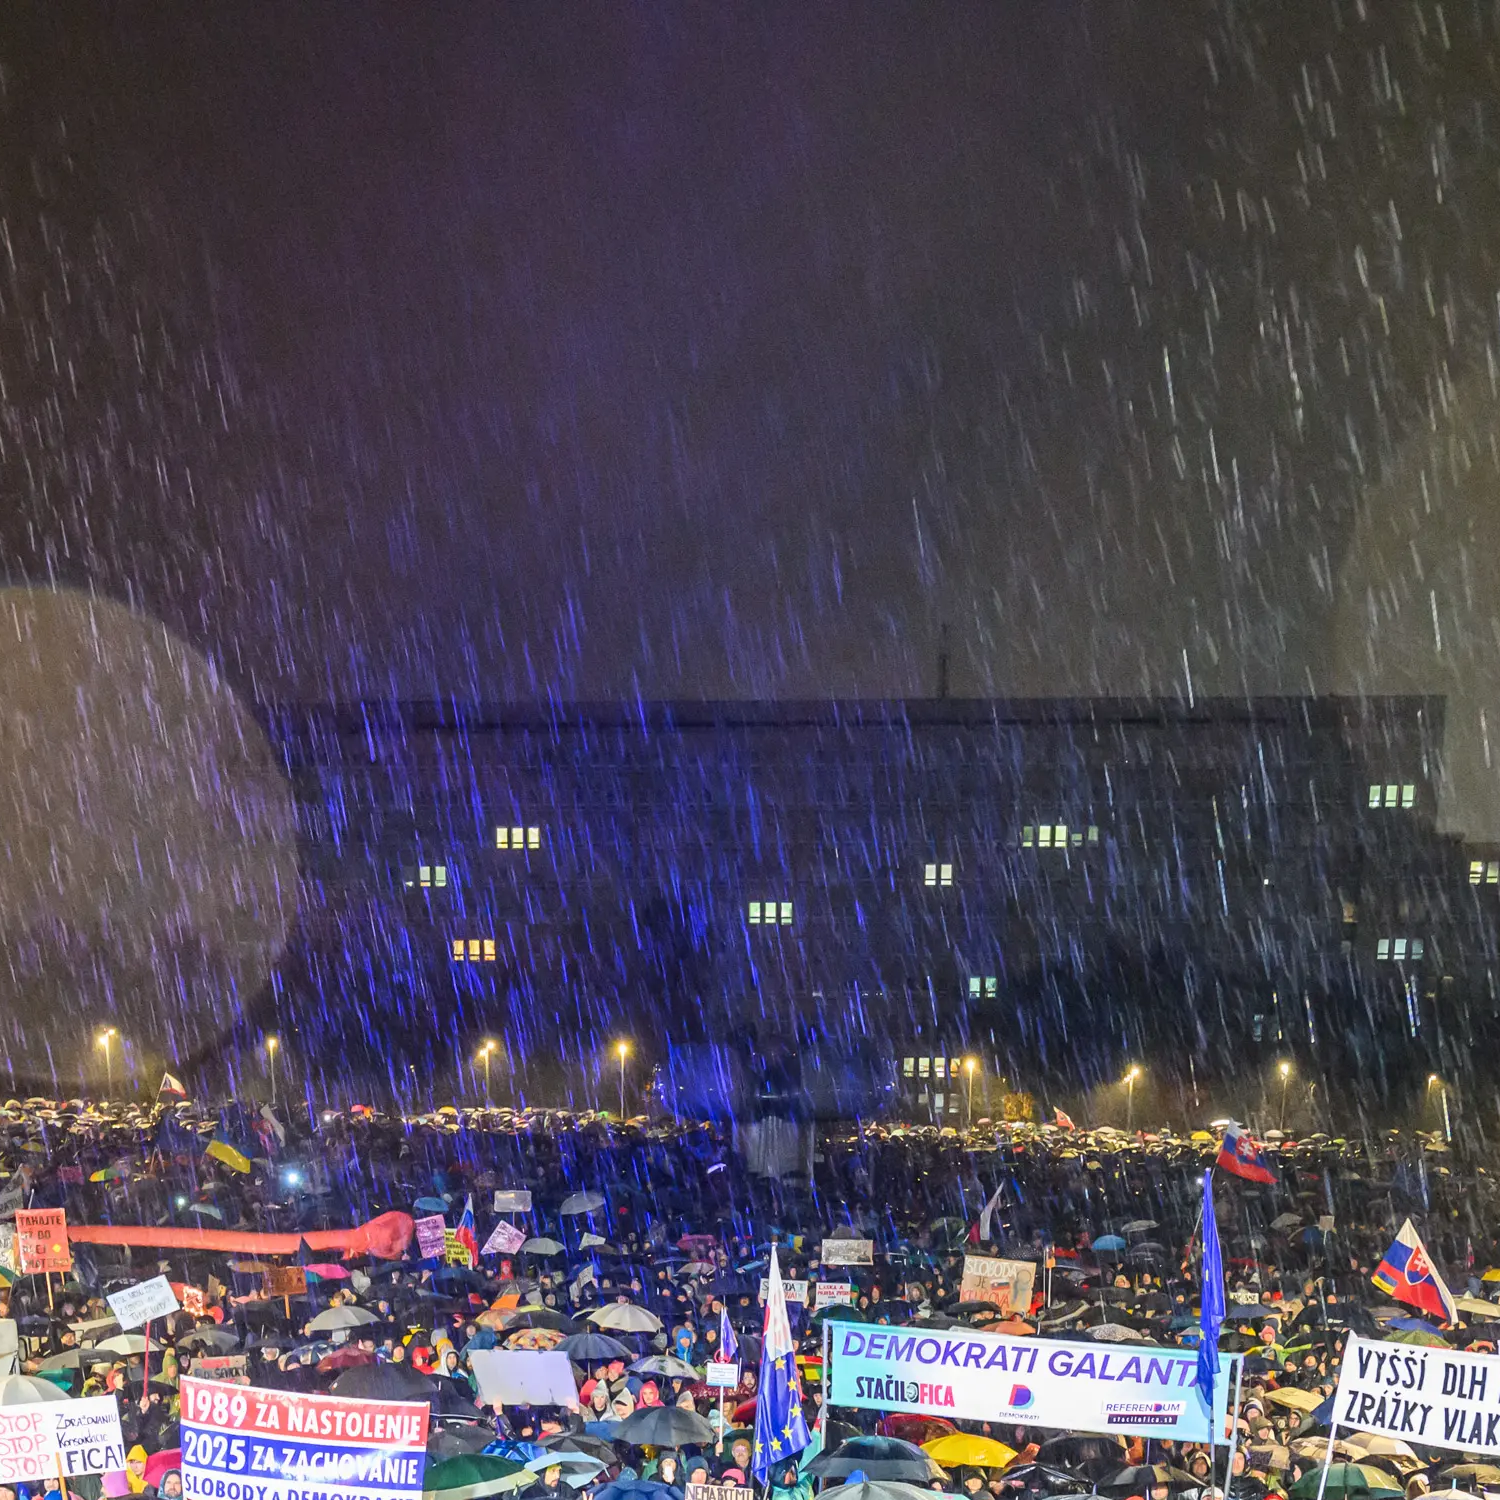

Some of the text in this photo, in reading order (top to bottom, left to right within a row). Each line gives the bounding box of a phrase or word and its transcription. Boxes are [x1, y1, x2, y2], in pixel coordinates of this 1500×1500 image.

[965, 1256, 1018, 1280] SLOBODA
[841, 1330, 1040, 1375] DEMOKRATI
[1358, 1346, 1429, 1391] VYŠŠÍ
[1442, 1362, 1488, 1401] DLH
[185, 1386, 422, 1442] 1989 ZA NASTOLENIE
[998, 1410, 1040, 1421] DEMOKRATI
[1105, 1401, 1181, 1416] REFERENDUM
[1344, 1390, 1434, 1436] ZRÁŽKY
[0, 1444, 125, 1479] STOP FICA!
[184, 1430, 419, 1486] 2025 ZA ZACHOVANIE
